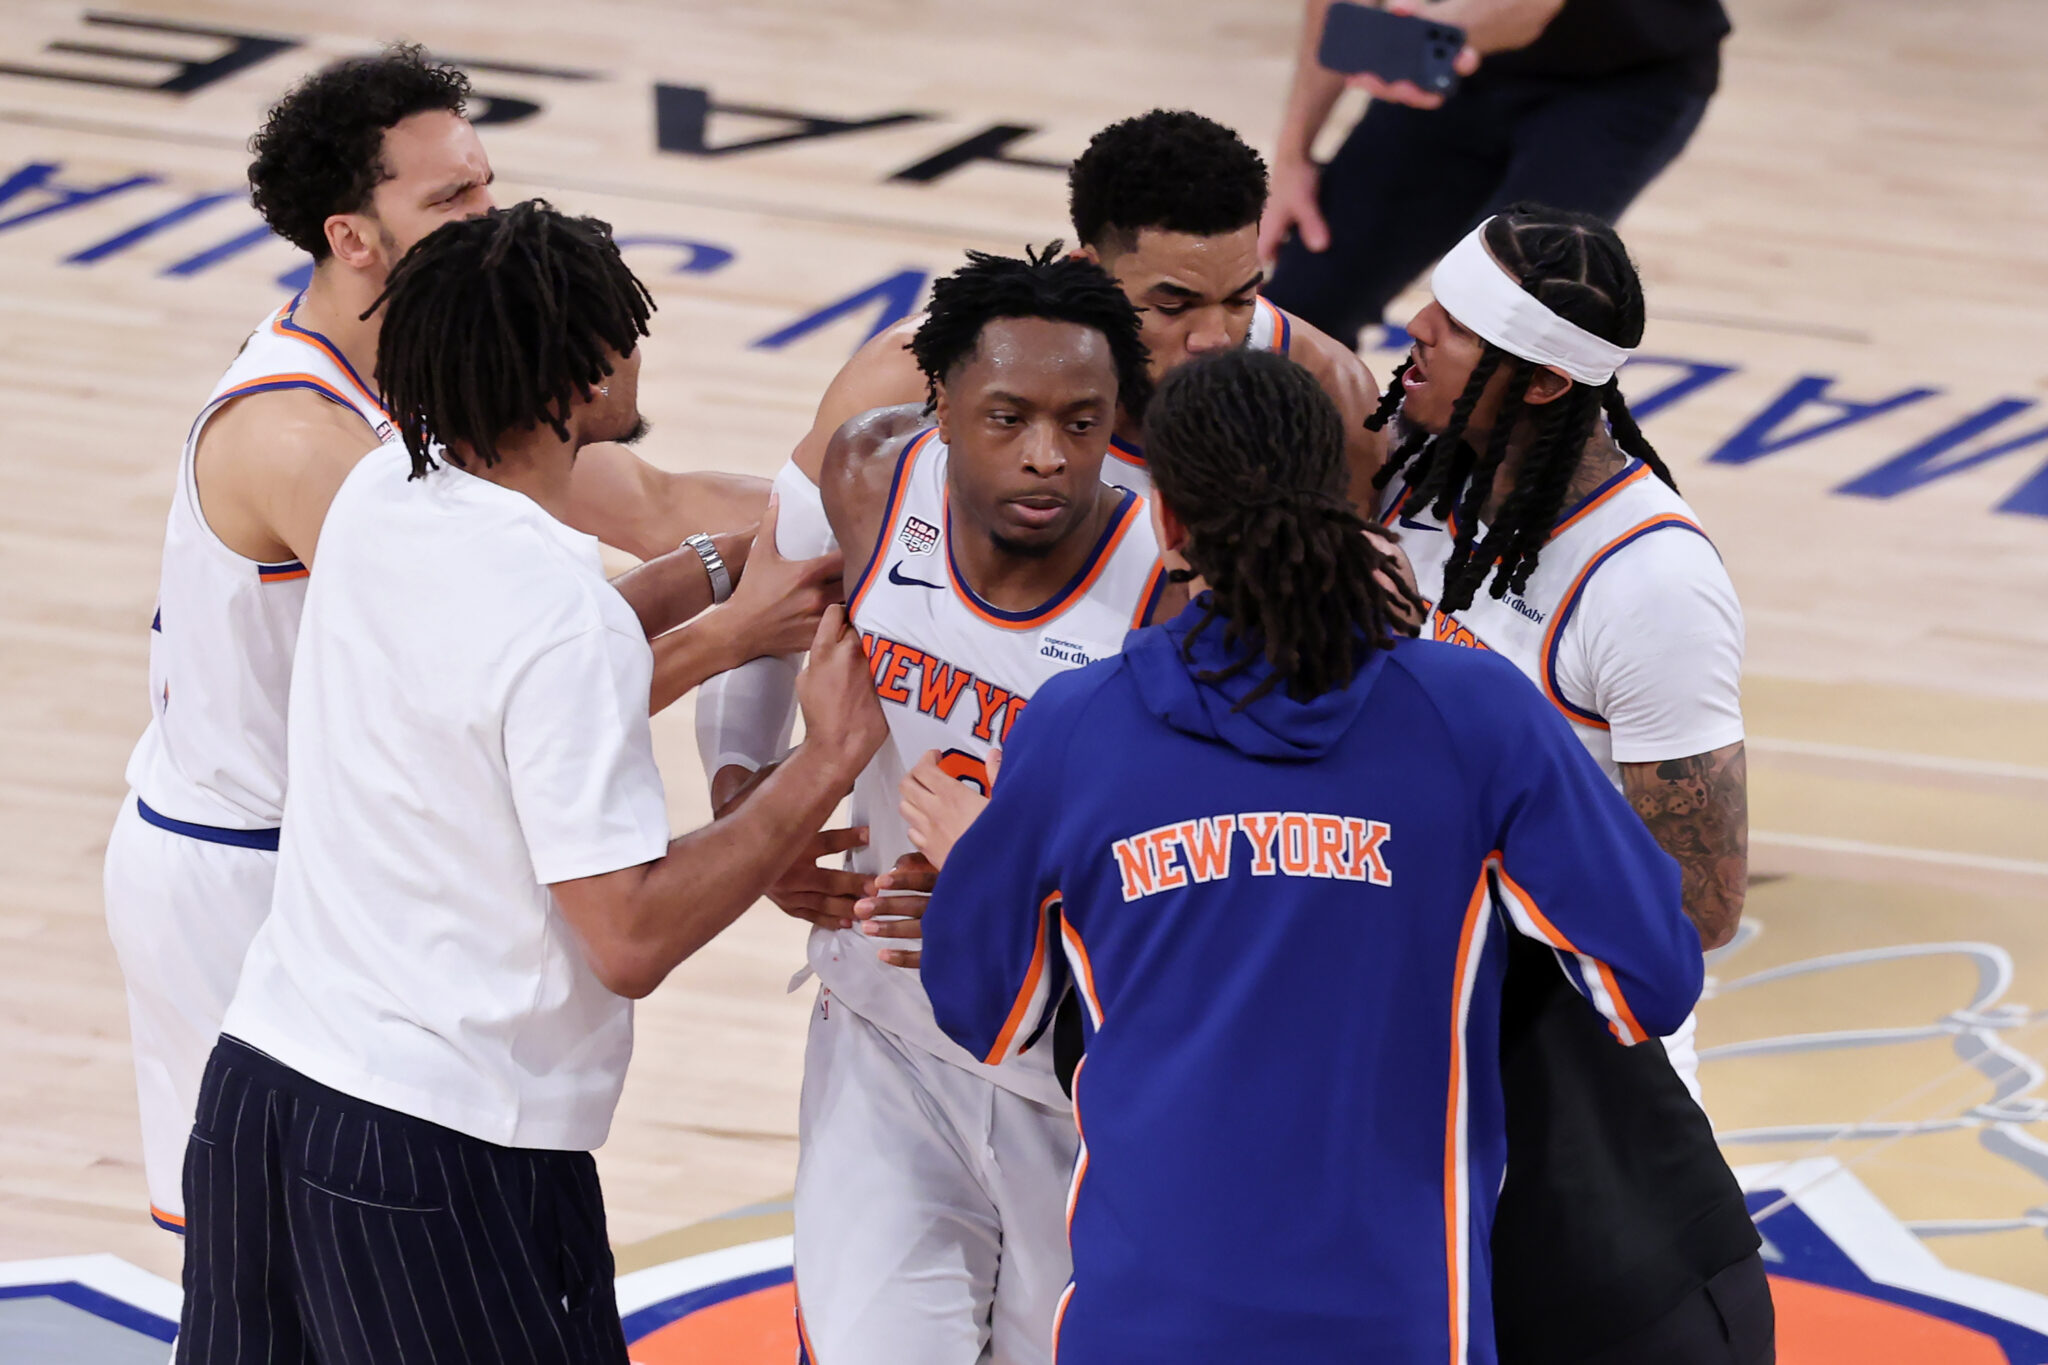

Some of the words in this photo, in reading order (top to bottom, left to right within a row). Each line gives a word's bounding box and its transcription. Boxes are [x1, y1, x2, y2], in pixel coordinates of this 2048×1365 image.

[907, 518, 937, 539] USA
[899, 531, 932, 553] 250
[1040, 645, 1069, 661] abu
[1112, 814, 1236, 902] NEW
[1238, 812, 1392, 887] YORK
